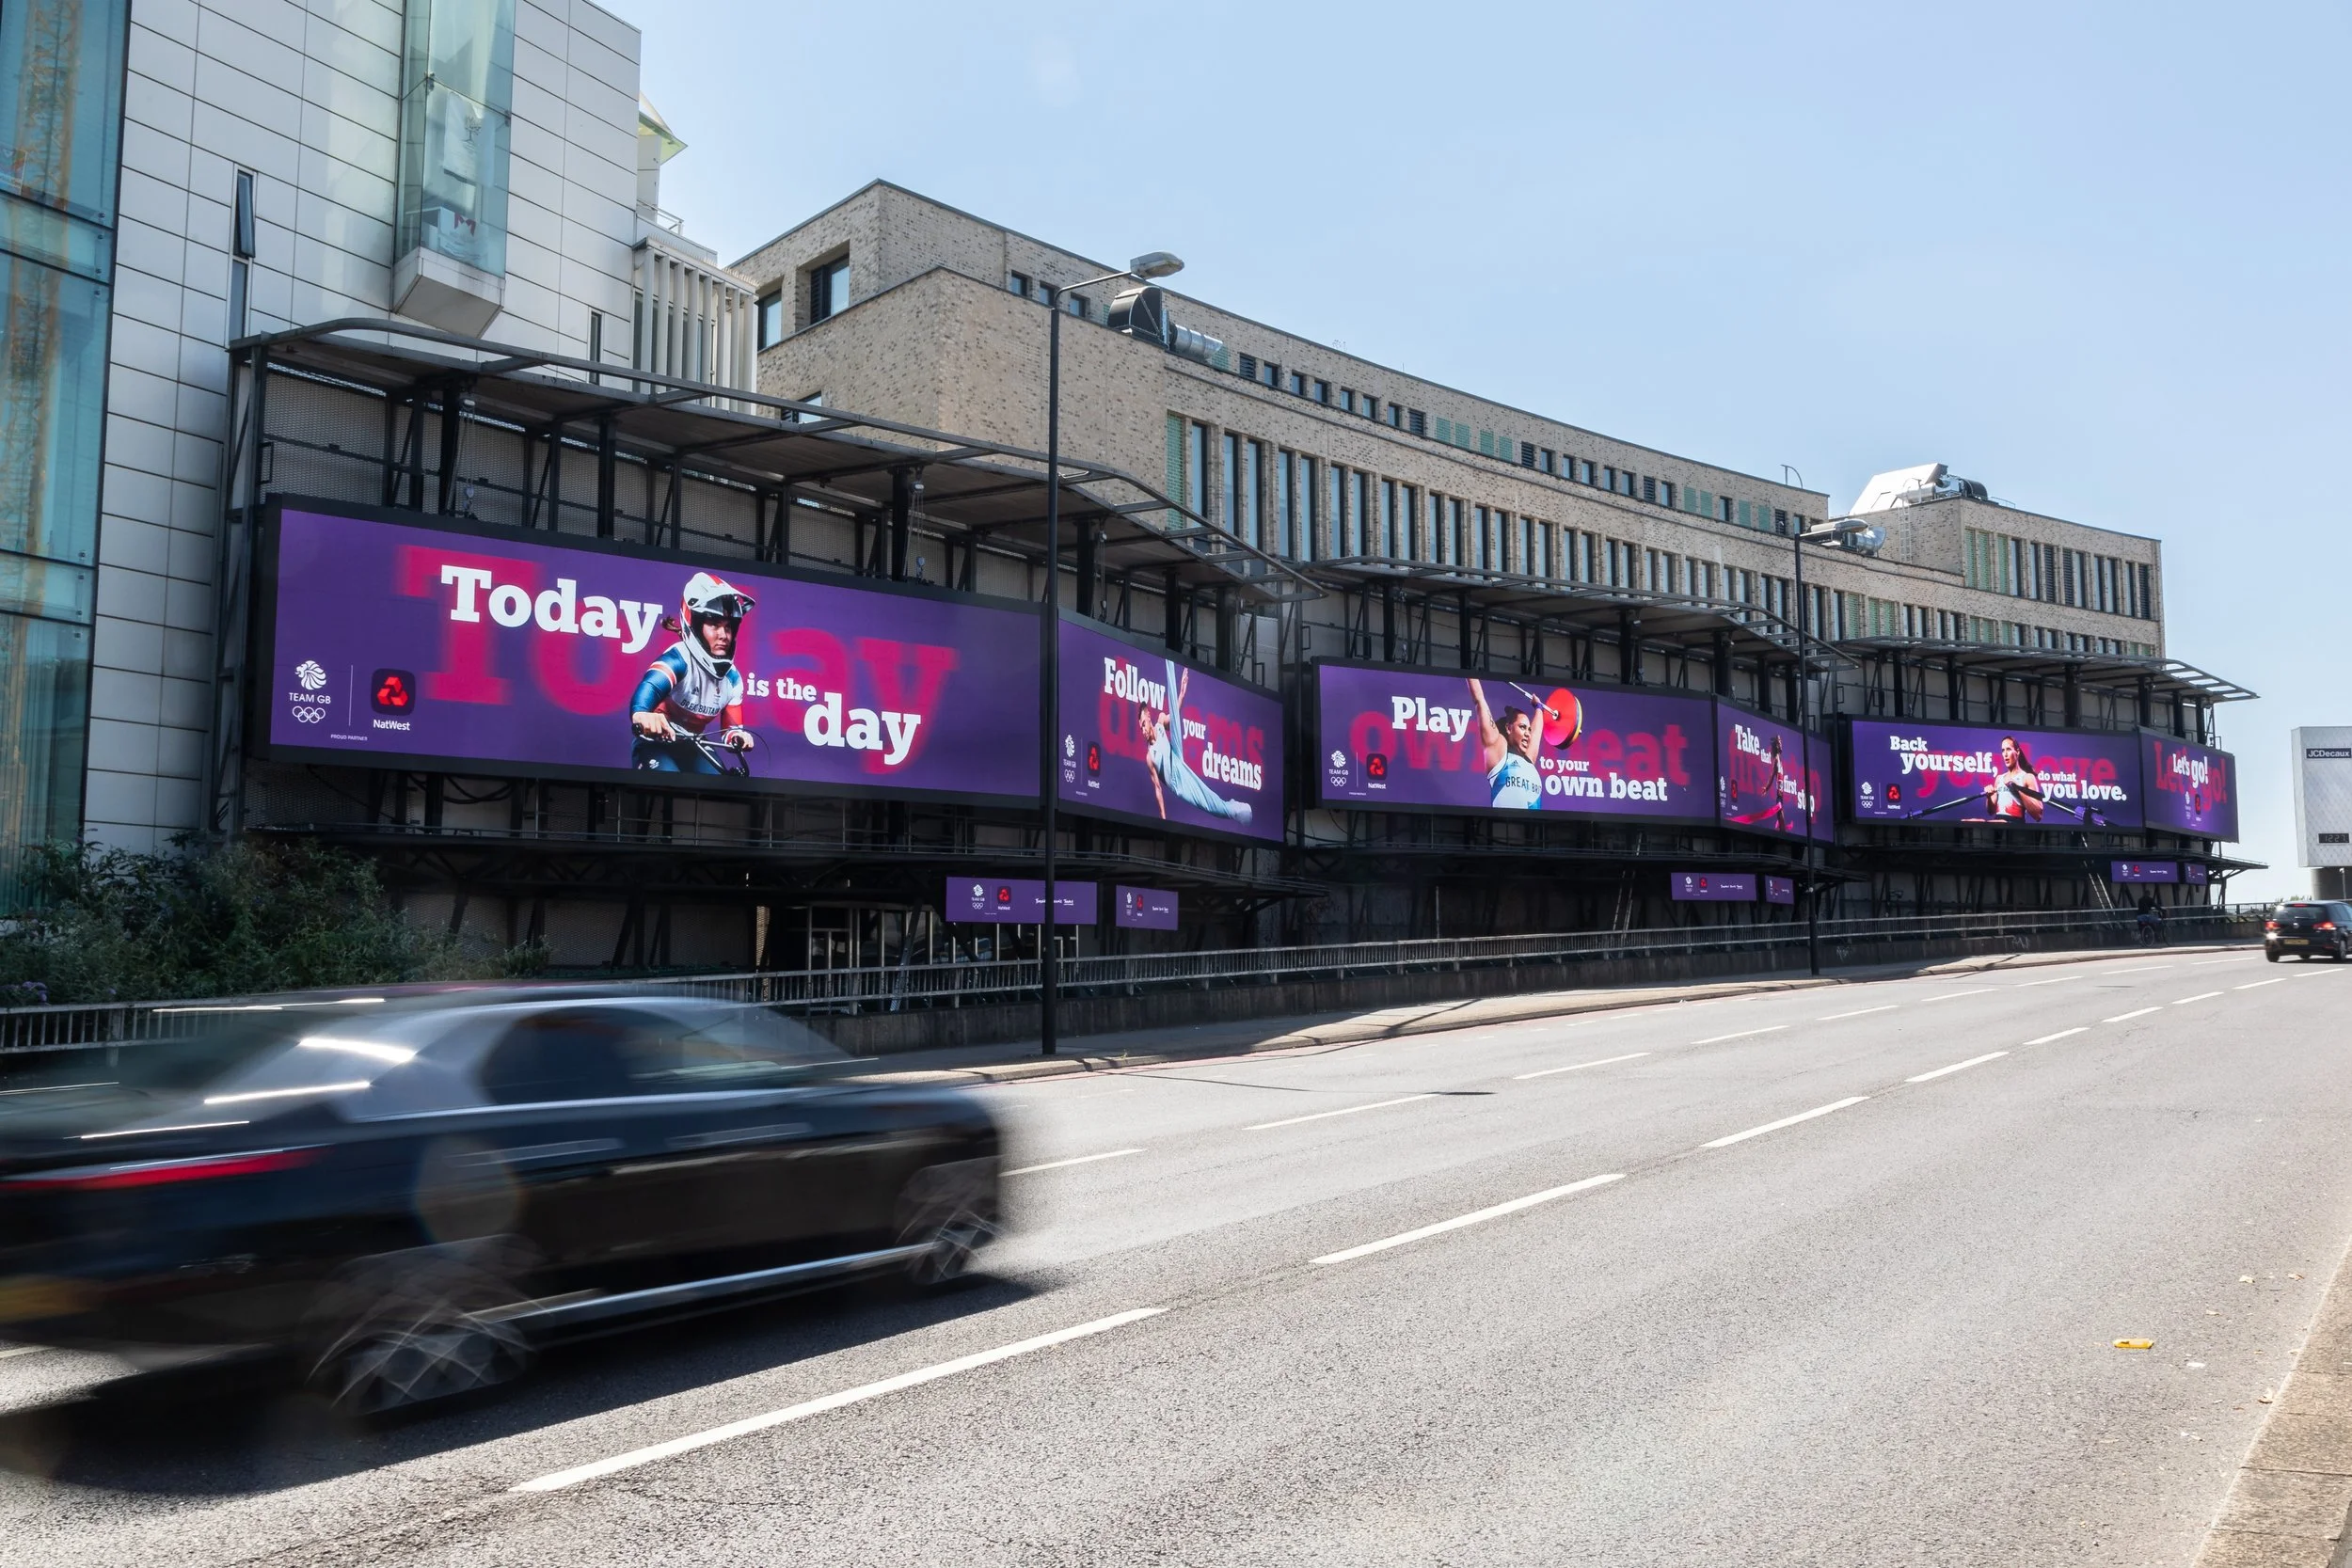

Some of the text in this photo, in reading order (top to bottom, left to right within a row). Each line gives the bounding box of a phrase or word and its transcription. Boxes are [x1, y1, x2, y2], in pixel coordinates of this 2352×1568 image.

[441, 564, 663, 654] Today
[746, 673, 817, 703] is the
[1104, 657, 1166, 710] Follow
[289, 692, 331, 704] TEAM GB
[373, 719, 411, 731] NatWest
[803, 691, 921, 765] day
[1183, 718, 1206, 739] your
[1391, 696, 1471, 742] Play
[1735, 723, 1760, 755] Take
[1889, 736, 1928, 752] Back
[1539, 755, 1589, 774] to your
[1760, 748, 1772, 764] that
[1899, 752, 1998, 777] yourself,
[2308, 749, 2350, 757] JCDecaux
[1202, 742, 1263, 790] dreams
[2038, 770, 2076, 783] do what
[2172, 753, 2209, 788] Let's go!
[1505, 776, 1529, 790] GREAT
[1545, 772, 1667, 801] own beat
[1783, 774, 1797, 795] first
[2041, 780, 2127, 801] you love.
[1797, 789, 1815, 817] stp
